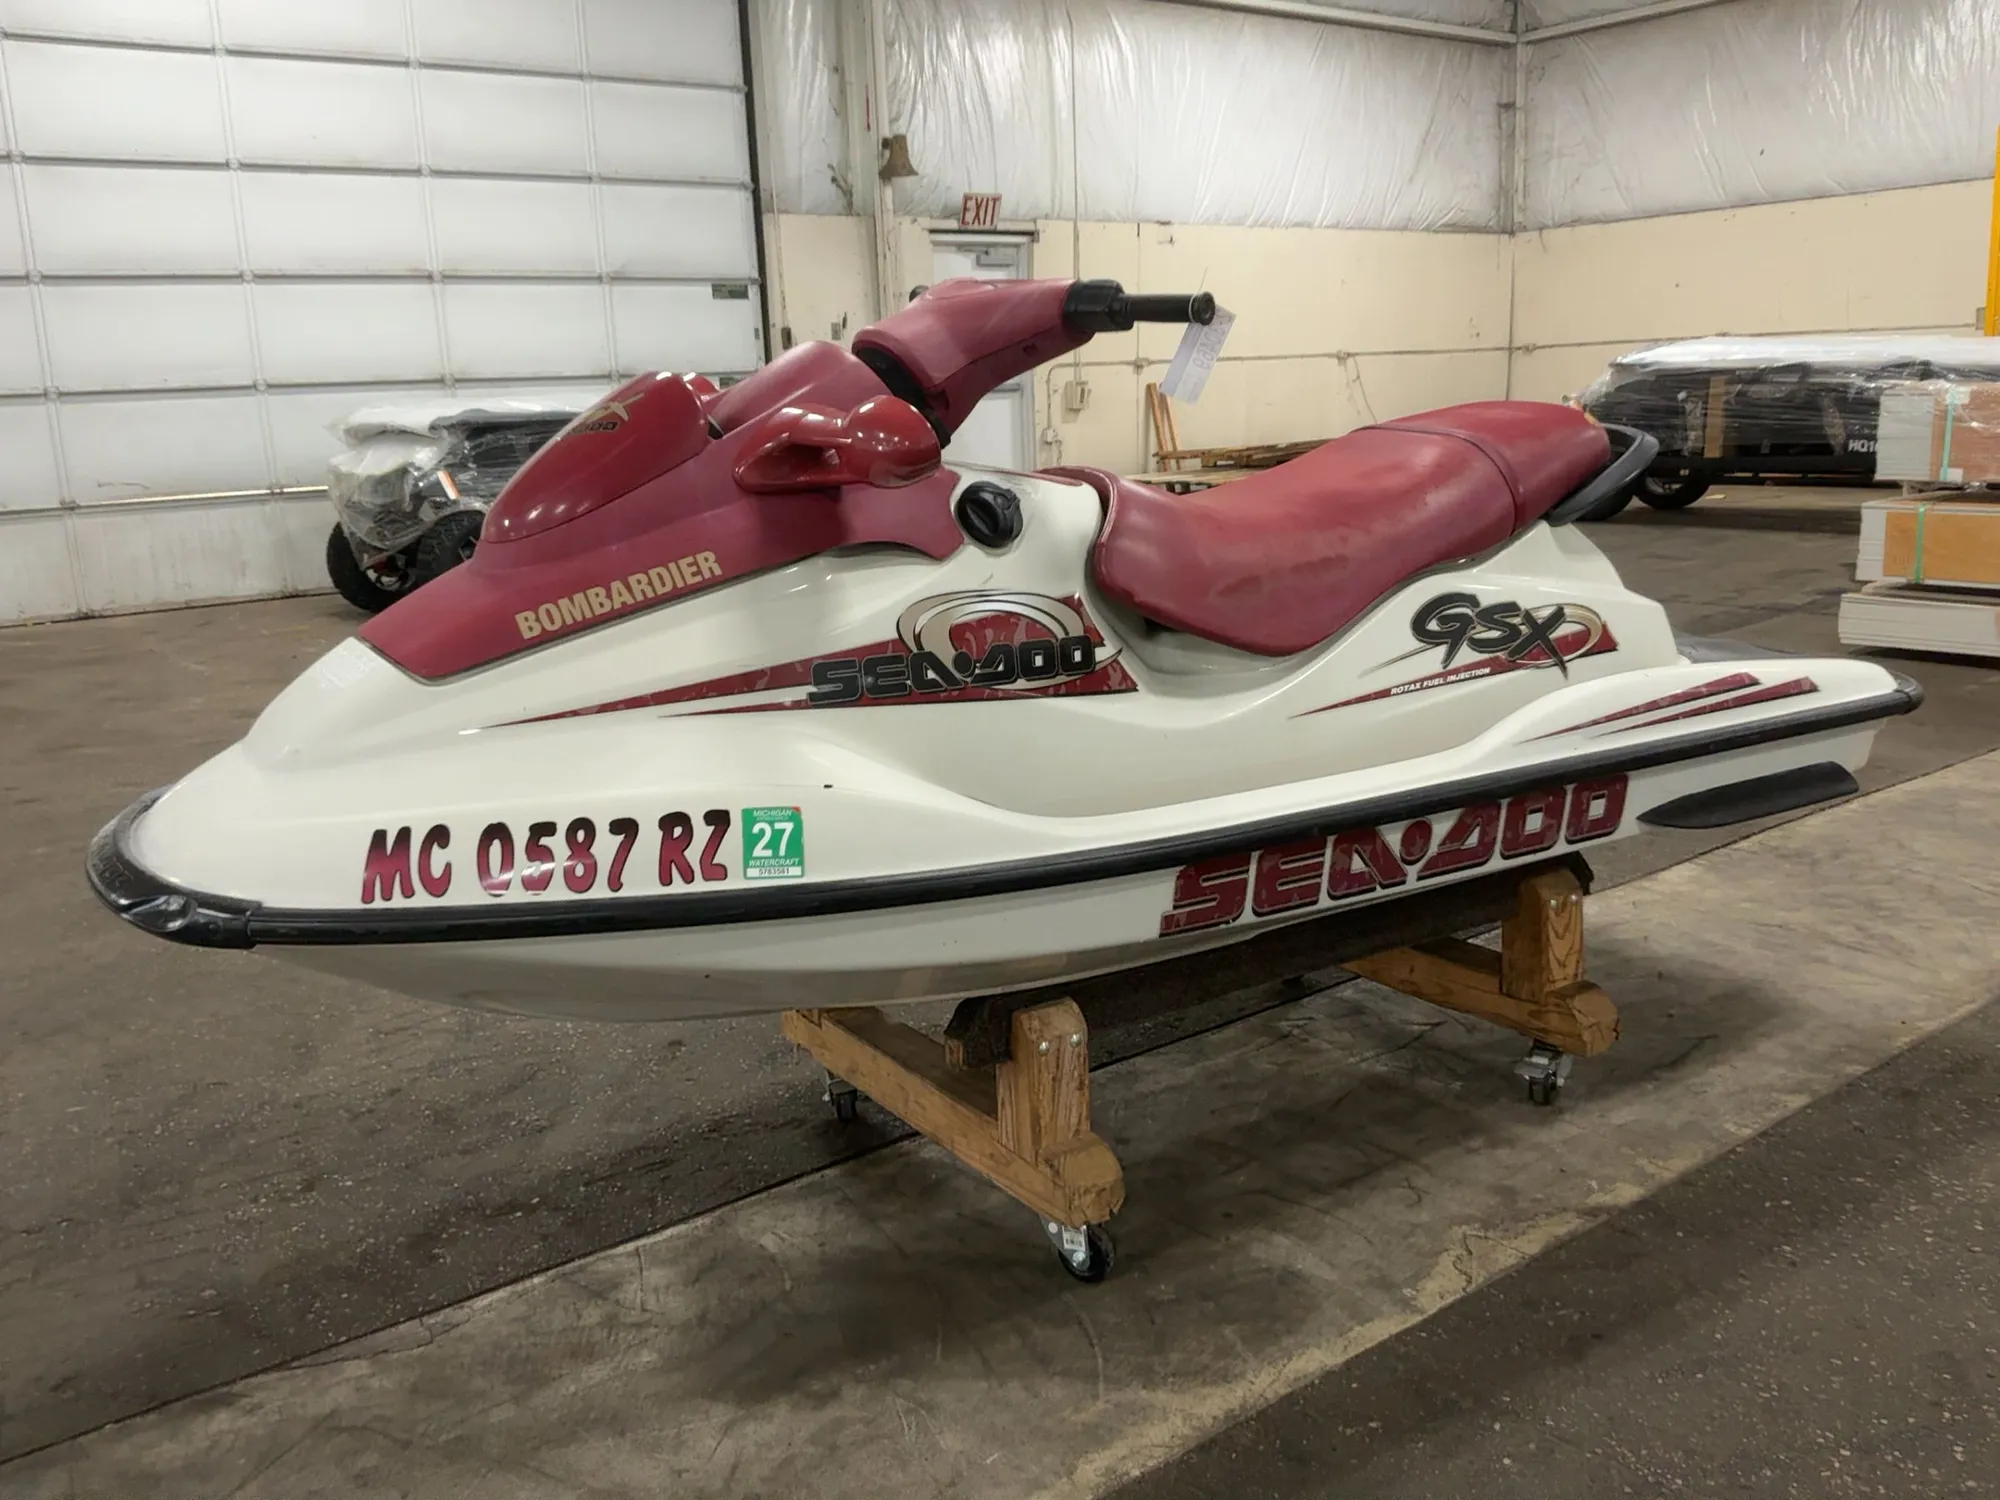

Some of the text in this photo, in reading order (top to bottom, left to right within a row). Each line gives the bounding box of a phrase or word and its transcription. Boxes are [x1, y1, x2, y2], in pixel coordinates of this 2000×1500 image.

[961, 196, 1000, 226] EXIT
[514, 550, 723, 640] BOMBARDIER
[1410, 592, 1569, 682] GSX
[1391, 667, 1490, 695] ROTAX FUEL INJECTION
[752, 822, 794, 857] 27
[361, 823, 451, 904] MC
[476, 817, 640, 898] 0587
[749, 858, 799, 867] WATERCRAFT
